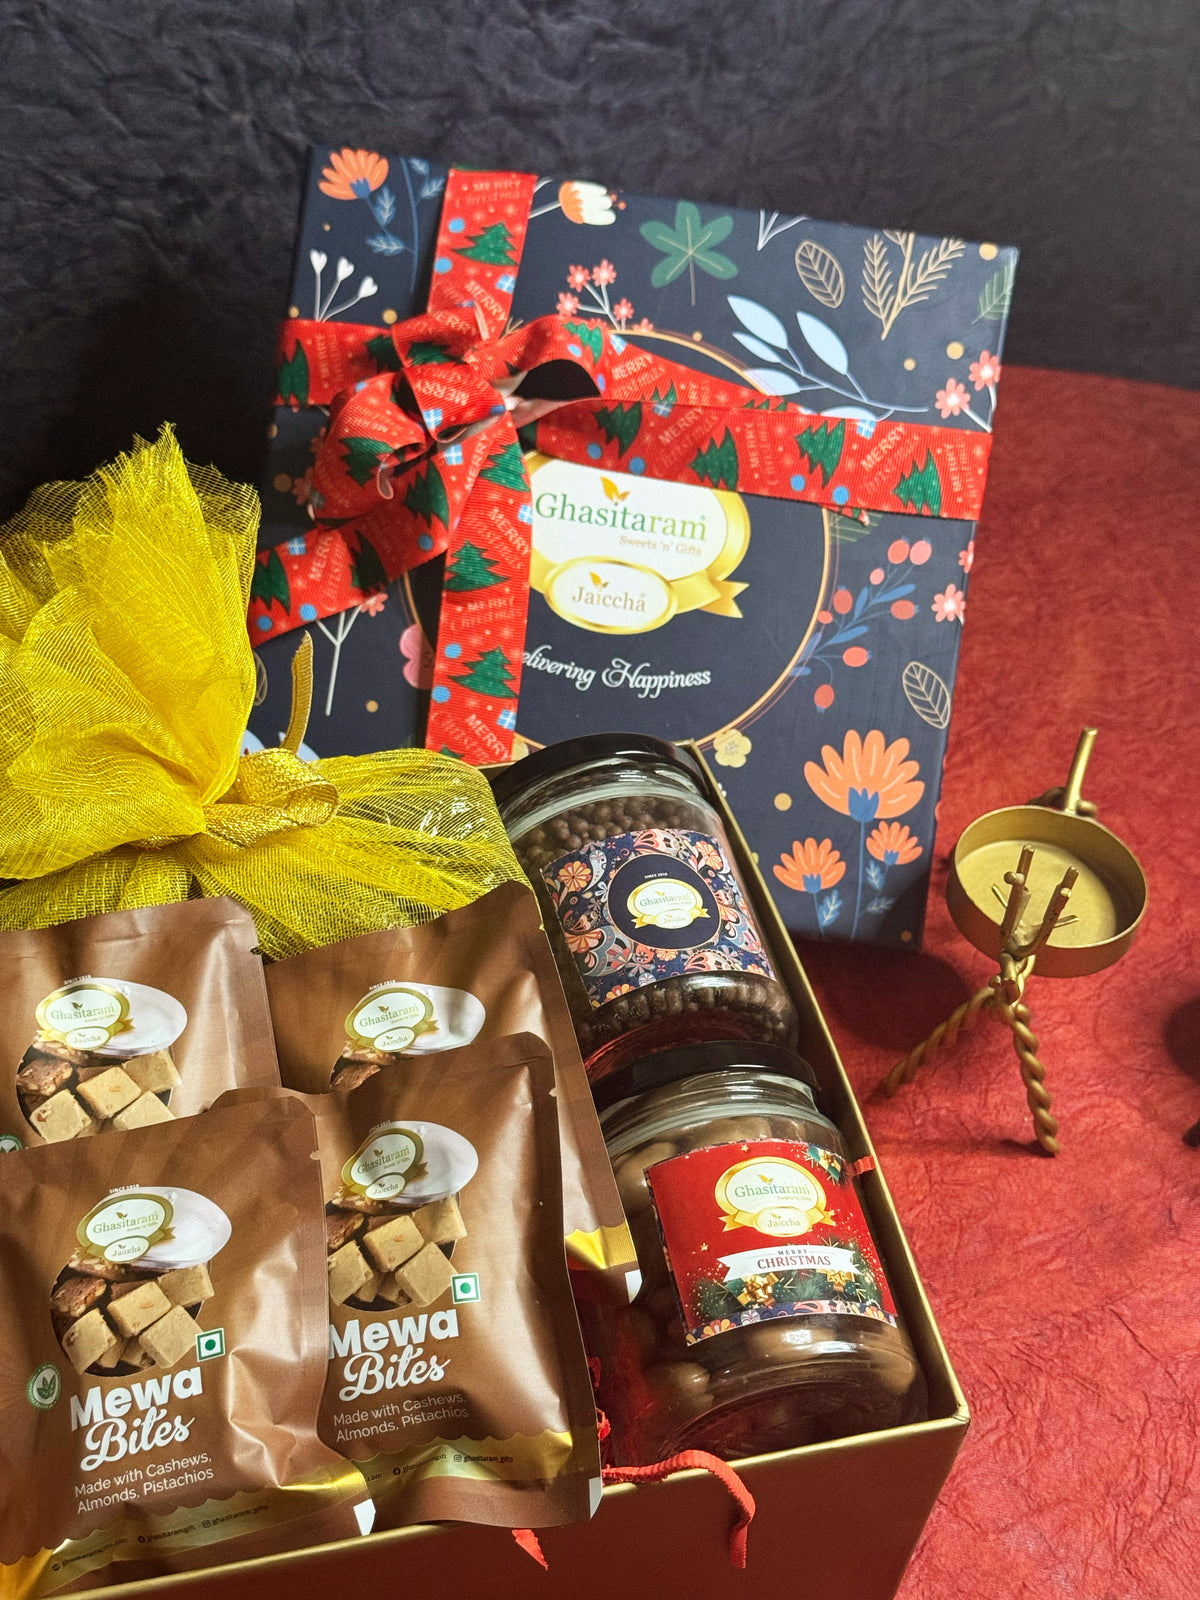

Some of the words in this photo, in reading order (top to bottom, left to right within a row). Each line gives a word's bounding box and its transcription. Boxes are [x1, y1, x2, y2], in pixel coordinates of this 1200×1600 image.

[464, 281, 507, 322] MERRY
[611, 353, 653, 380] MERRY
[658, 407, 704, 445] MERRY
[465, 432, 488, 491] MERRY
[861, 426, 905, 472] MERRY
[487, 507, 528, 554] MERRY
[535, 492, 708, 541] Ghasitaram
[619, 534, 657, 551] Sweets
[676, 542, 702, 556] Gifts
[572, 586, 646, 612] Jaiccha
[522, 645, 596, 691] elivering
[601, 657, 711, 699] Happiness
[466, 713, 509, 760] MERRY
[51, 1004, 115, 1020] Ghasitaram
[360, 1003, 419, 1027] Ghasitaram
[357, 1146, 410, 1174] Ghasitaram
[734, 1182, 811, 1198] Ghasitaram
[93, 1211, 159, 1233] Ghasitaram
[767, 1217, 800, 1228] Jaiccha
[757, 1256, 831, 1269] CHRISTMAS
[328, 1308, 459, 1360] Mewa
[339, 1344, 451, 1402] Bites
[70, 1366, 203, 1432] Mewa
[333, 1410, 369, 1426] Made
[371, 1403, 400, 1418] with
[402, 1392, 467, 1412] Cashews,
[80, 1406, 195, 1472] Bites
[336, 1420, 399, 1442] Almonds,
[401, 1406, 469, 1427] Pistachios
[74, 1477, 111, 1497] Made
[113, 1469, 143, 1487] with
[146, 1451, 212, 1477] Cashews,
[77, 1487, 140, 1514] Almonds,
[143, 1468, 214, 1496] Pistachios
